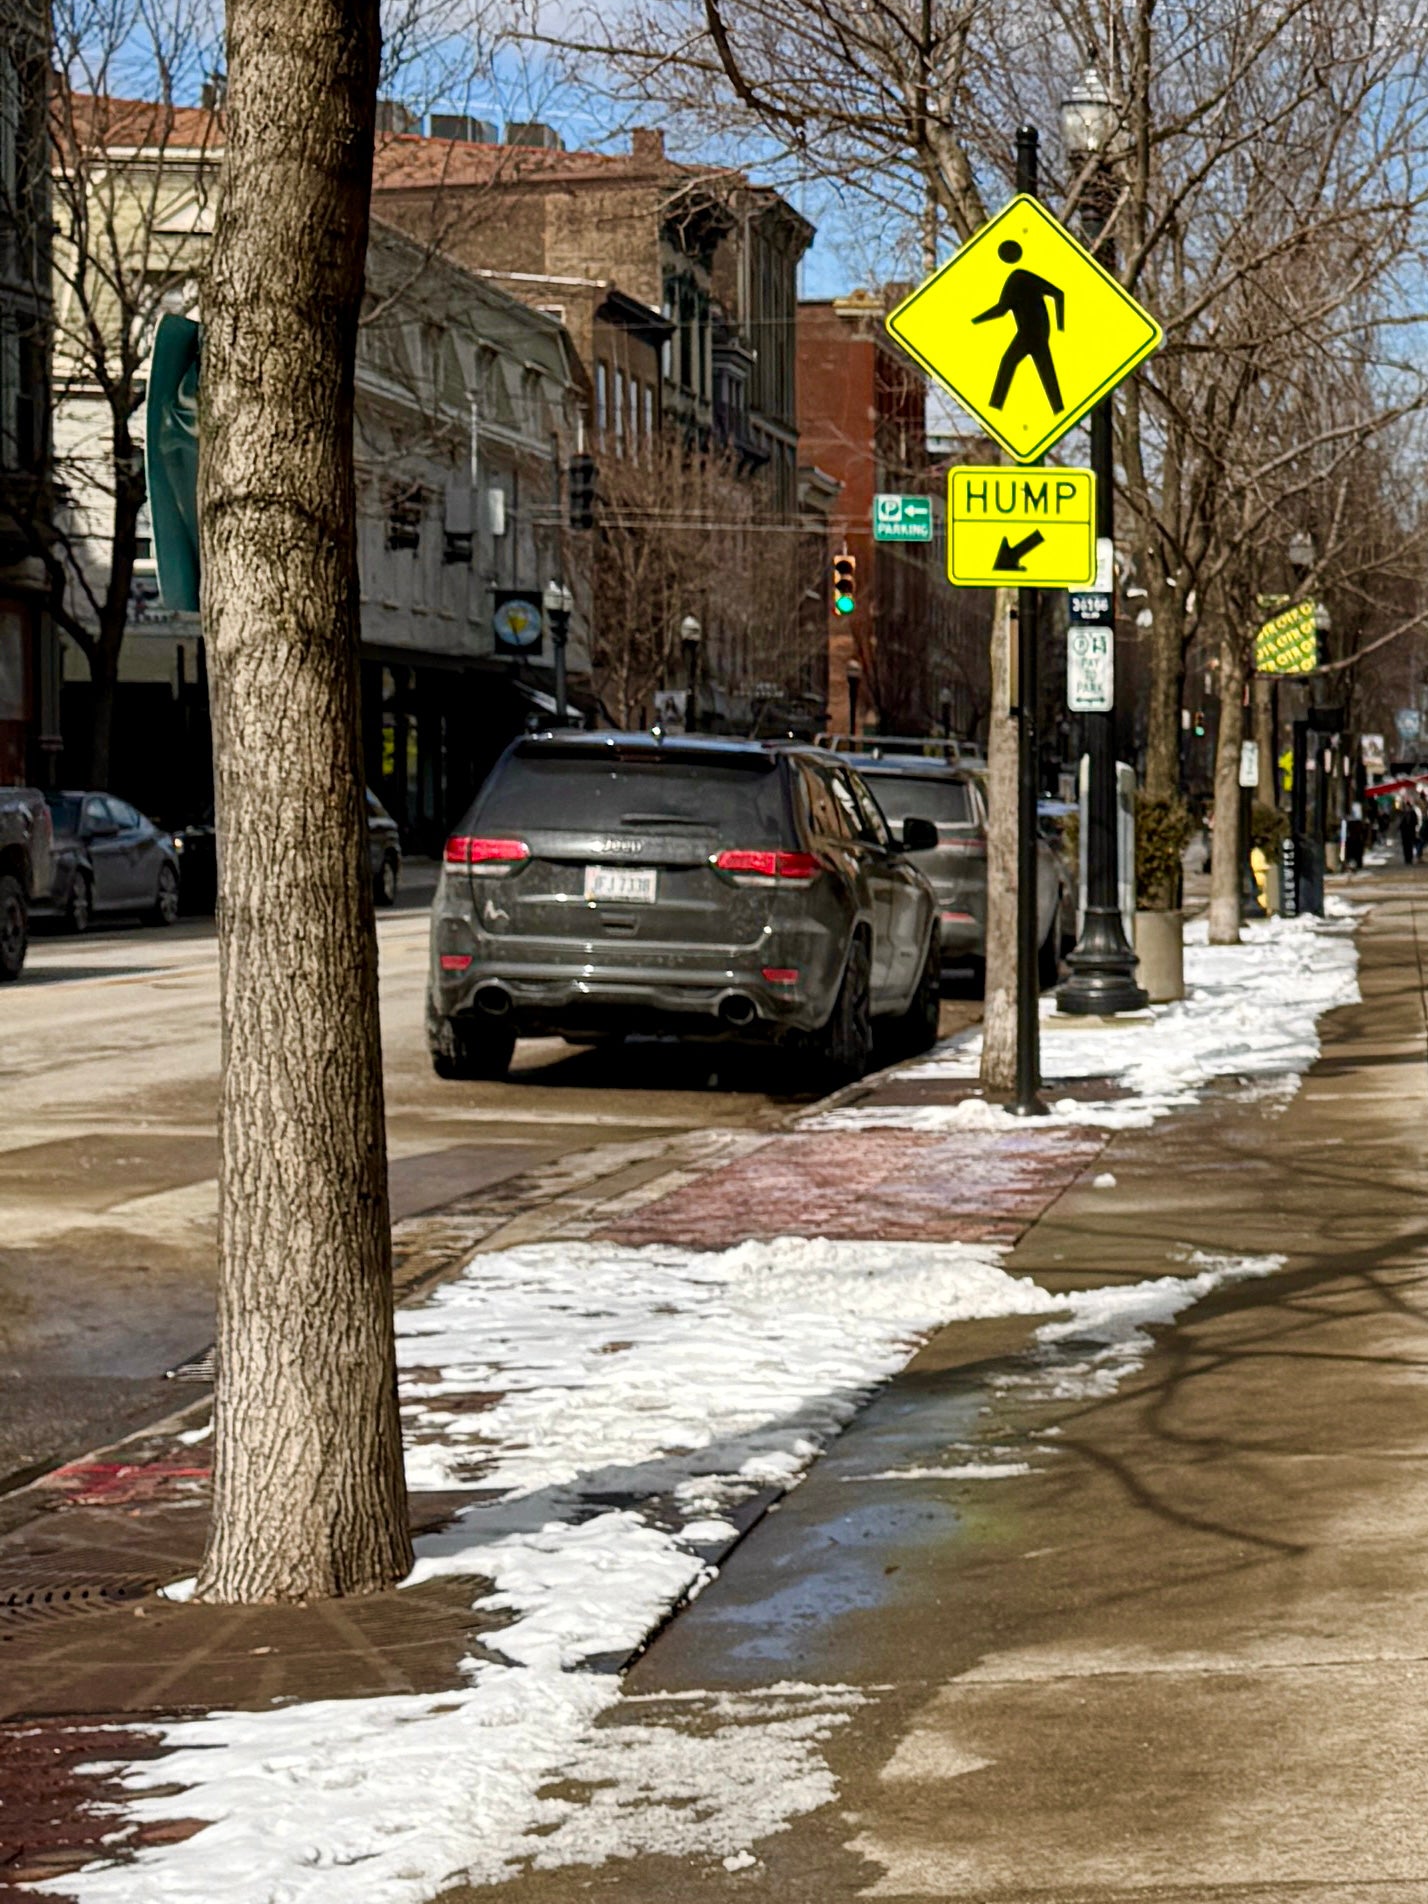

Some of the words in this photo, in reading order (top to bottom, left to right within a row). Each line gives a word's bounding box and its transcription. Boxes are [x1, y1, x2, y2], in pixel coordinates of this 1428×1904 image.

[966, 480, 1077, 515] HUMP
[877, 522, 929, 536] PARKING
[1081, 657, 1099, 669] PAY
[1076, 682, 1103, 693] PARK
[601, 839, 642, 854] Jeep
